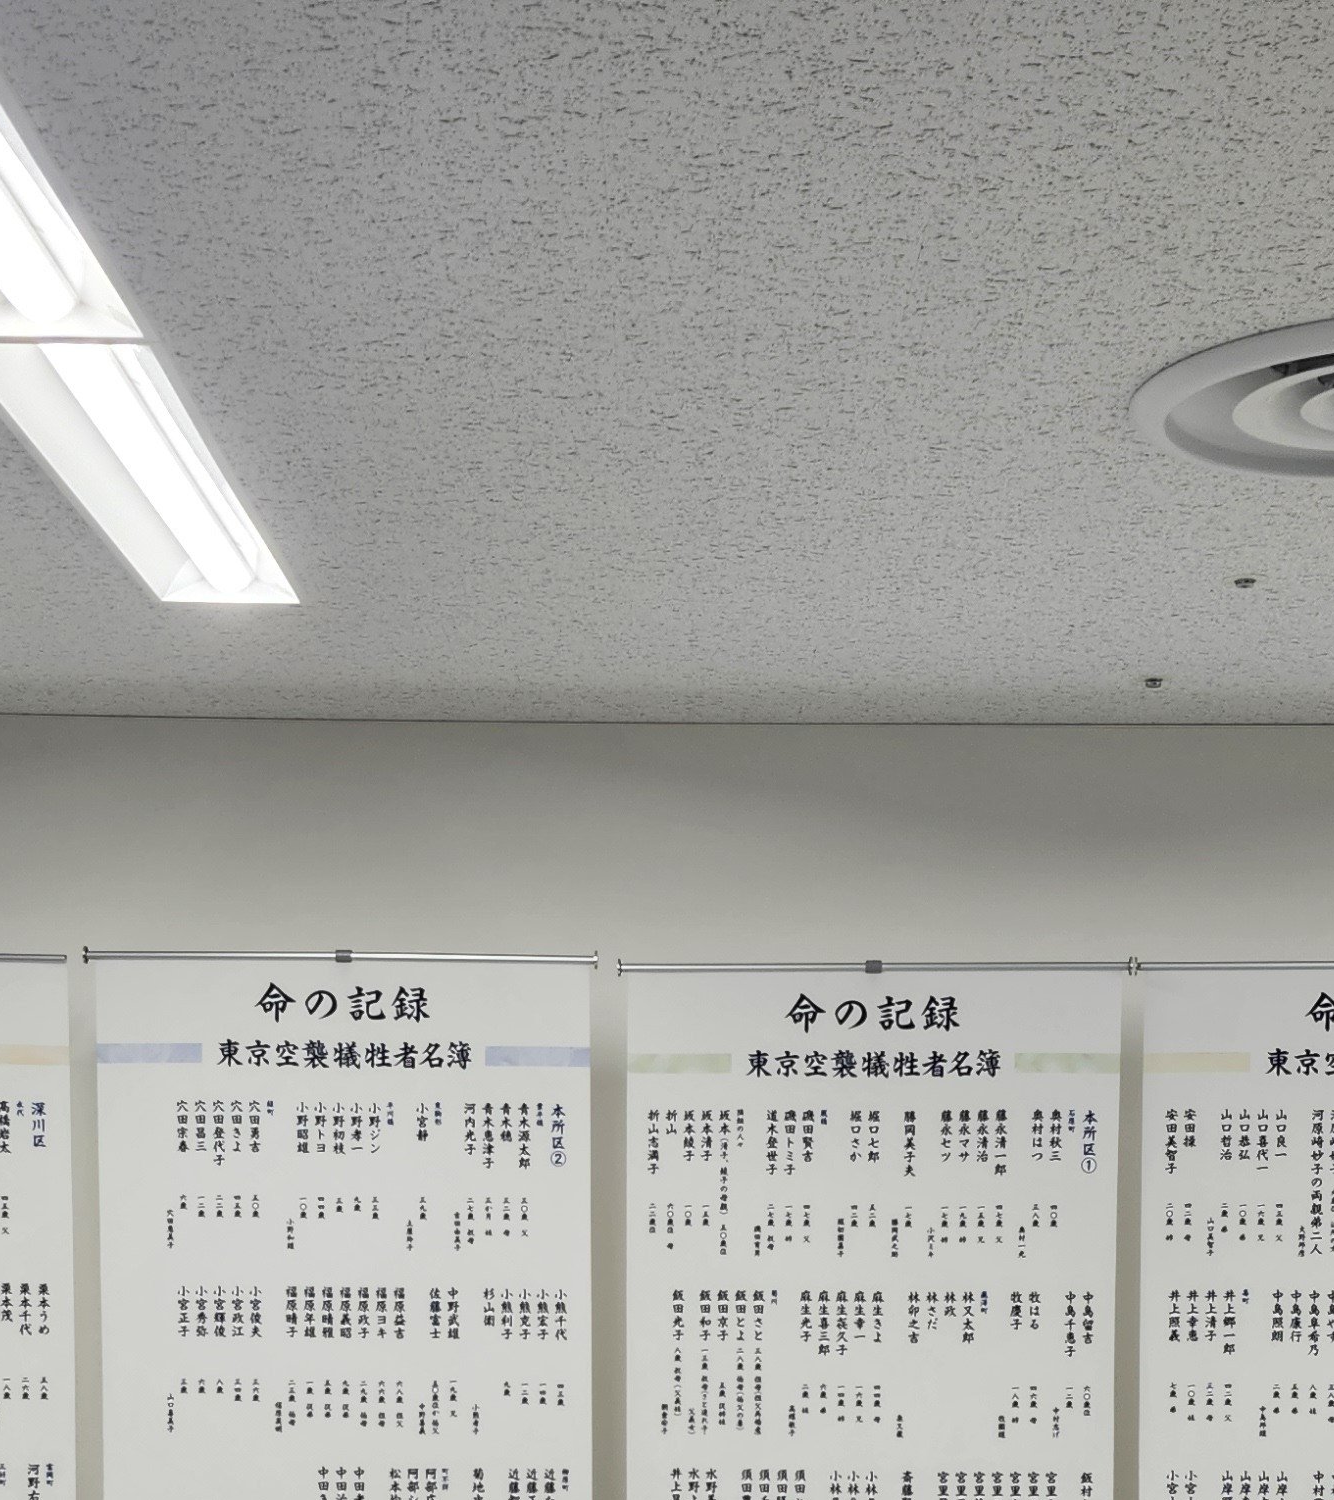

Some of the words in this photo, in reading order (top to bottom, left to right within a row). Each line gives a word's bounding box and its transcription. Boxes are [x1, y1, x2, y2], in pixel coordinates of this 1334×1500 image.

[254, 981, 431, 1024] 命の記録
[784, 992, 960, 1035] 命の記録
[217, 1038, 472, 1071] 東京空襲犠牲者名簿
[746, 1048, 1001, 1079] 東京空襲犠牲者名簿
[30, 1101, 47, 1148] 深川区
[194, 1099, 208, 1152] 穴田昌三
[313, 1101, 328, 1153] 小野トヨ
[332, 1102, 347, 1156] 小野初枝
[349, 1102, 364, 1151] 小野孝一
[463, 1102, 477, 1156] 河内光子
[517, 1102, 532, 1170] 青木源太郎
[549, 1103, 567, 1168] 本所区②
[1031, 1108, 1045, 1162] 奥村はつ
[1080, 1109, 1099, 1175] 本所区①
[1164, 1108, 1179, 1175] 安田美智子
[177, 1285, 191, 1338] 小宮正子
[356, 1286, 371, 1340] 福原政子
[554, 1288, 568, 1341] 小熊千代
[925, 1291, 940, 1331] 林さだ
[961, 1290, 976, 1345] 林又太郎
[1204, 1288, 1218, 1342] 井上清子
